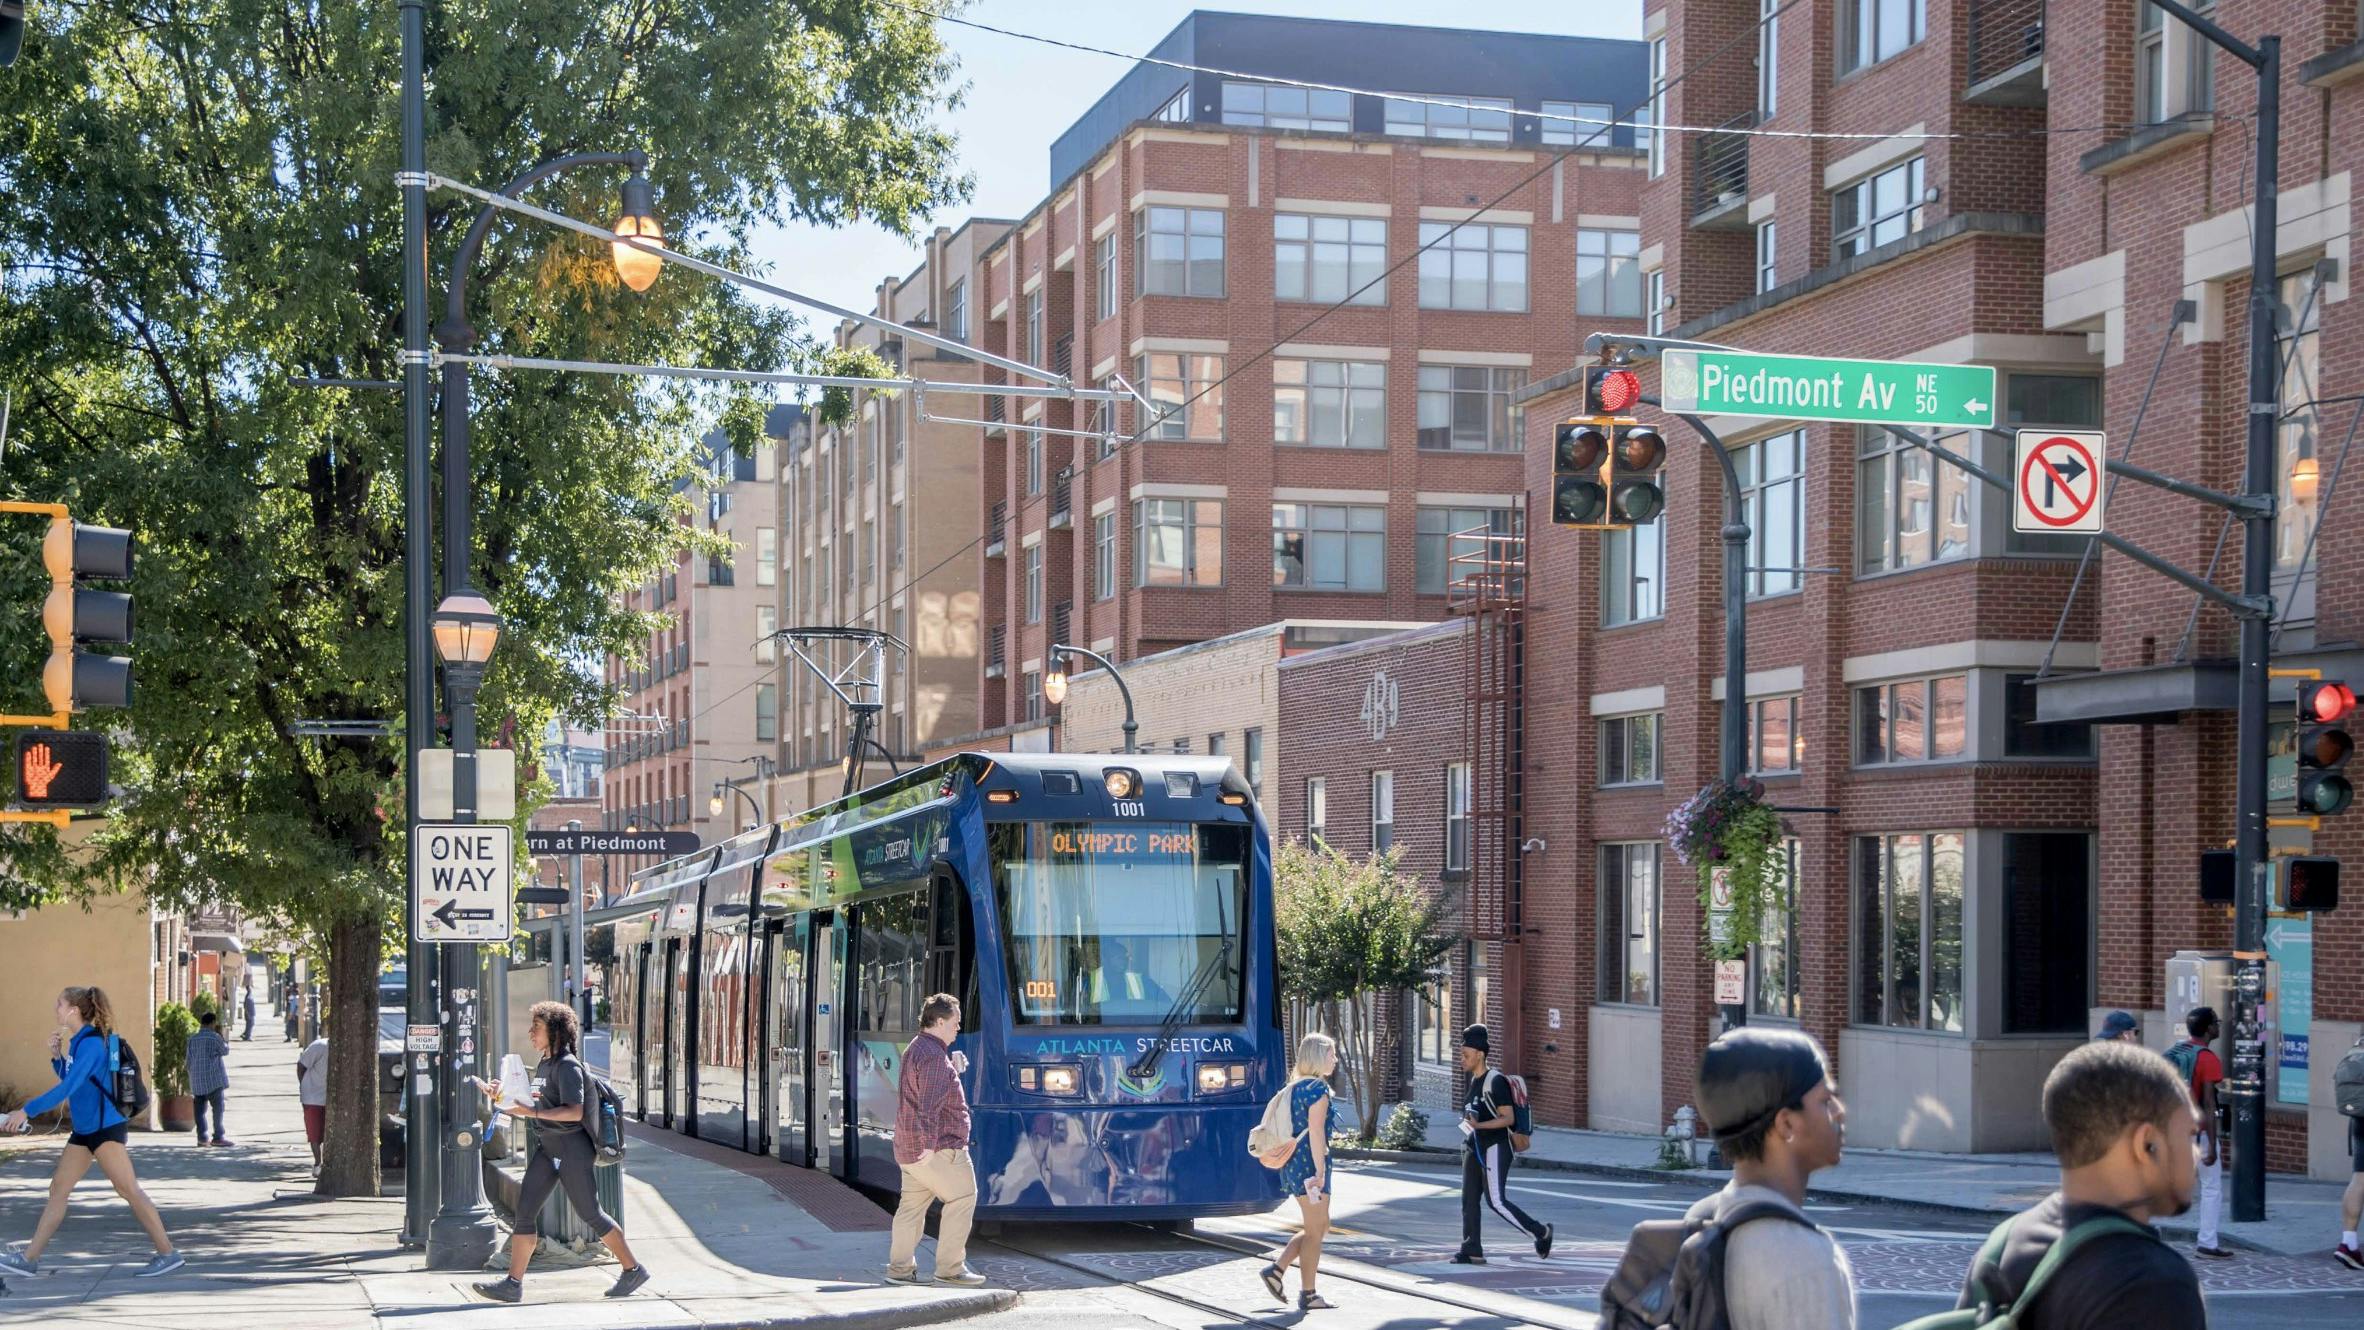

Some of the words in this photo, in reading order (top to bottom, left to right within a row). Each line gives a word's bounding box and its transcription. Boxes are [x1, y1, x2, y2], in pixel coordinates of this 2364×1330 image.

[1703, 364, 1844, 409] Piedmont
[1857, 372, 1897, 411] Av
[1916, 374, 1938, 393] NE
[1915, 395, 1938, 414] 50
[1112, 802, 1145, 817] 1001
[431, 835, 493, 860] ONE
[555, 837, 575, 850] at
[580, 836, 666, 850] Piedmont
[1052, 833, 1137, 852] OLYMPIC
[1149, 834, 1197, 853] PARK
[432, 867, 496, 891] WAY
[1724, 965, 1736, 973] NO
[1027, 981, 1057, 998] 001
[1036, 1039, 1126, 1054] ATLANTA
